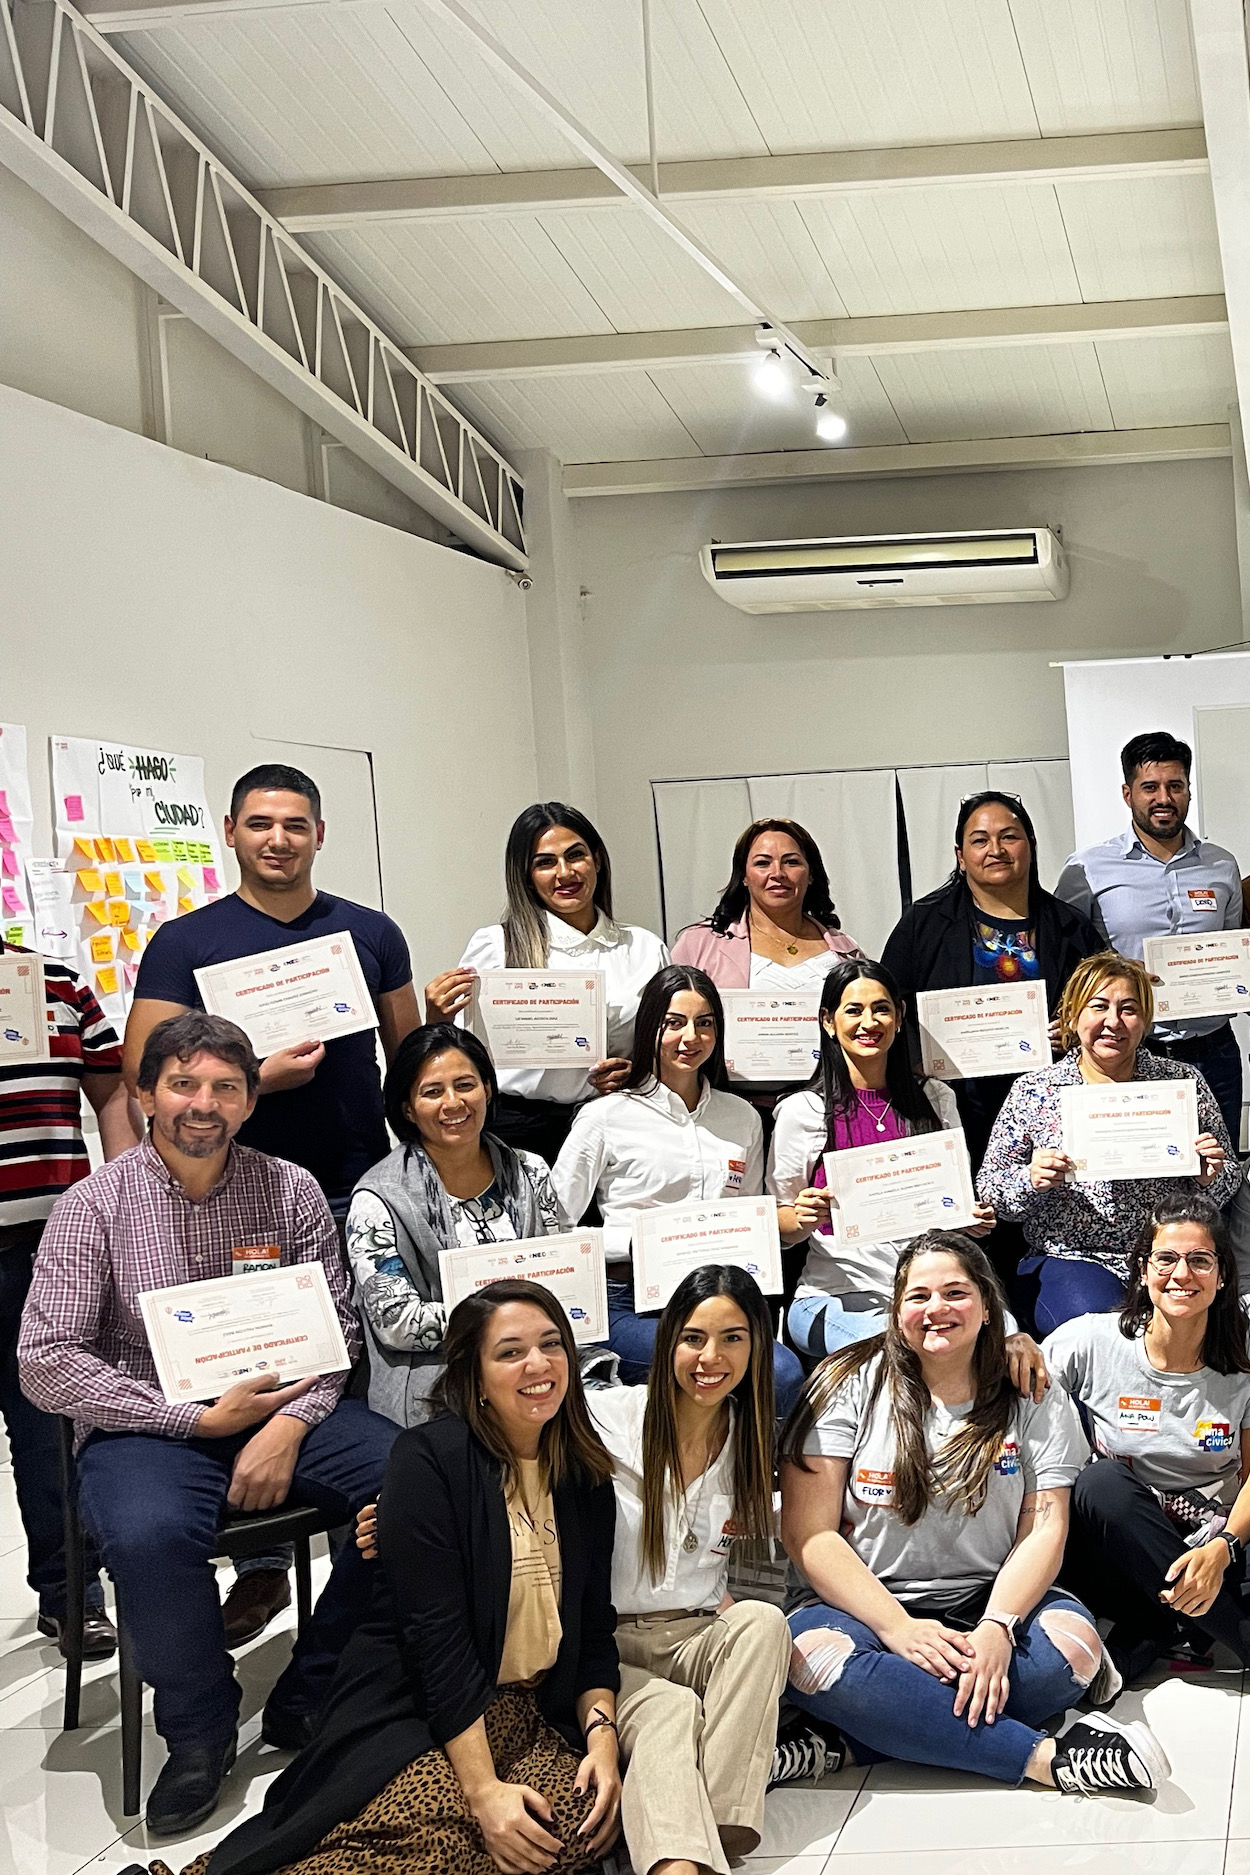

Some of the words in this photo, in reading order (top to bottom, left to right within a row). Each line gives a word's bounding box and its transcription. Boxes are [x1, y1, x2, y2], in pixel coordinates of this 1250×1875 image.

[155, 801, 205, 828] CIUDAD?
[235, 983, 274, 997] CERTIFICADO
[944, 1014, 976, 1022] CERTIFICADO
[856, 1172, 891, 1183] CERTIFICADO
[661, 1232, 698, 1242] CERTIFICADO
[264, 1335, 308, 1349] CERTIFICADO
[862, 1486, 885, 1496] FLOR
